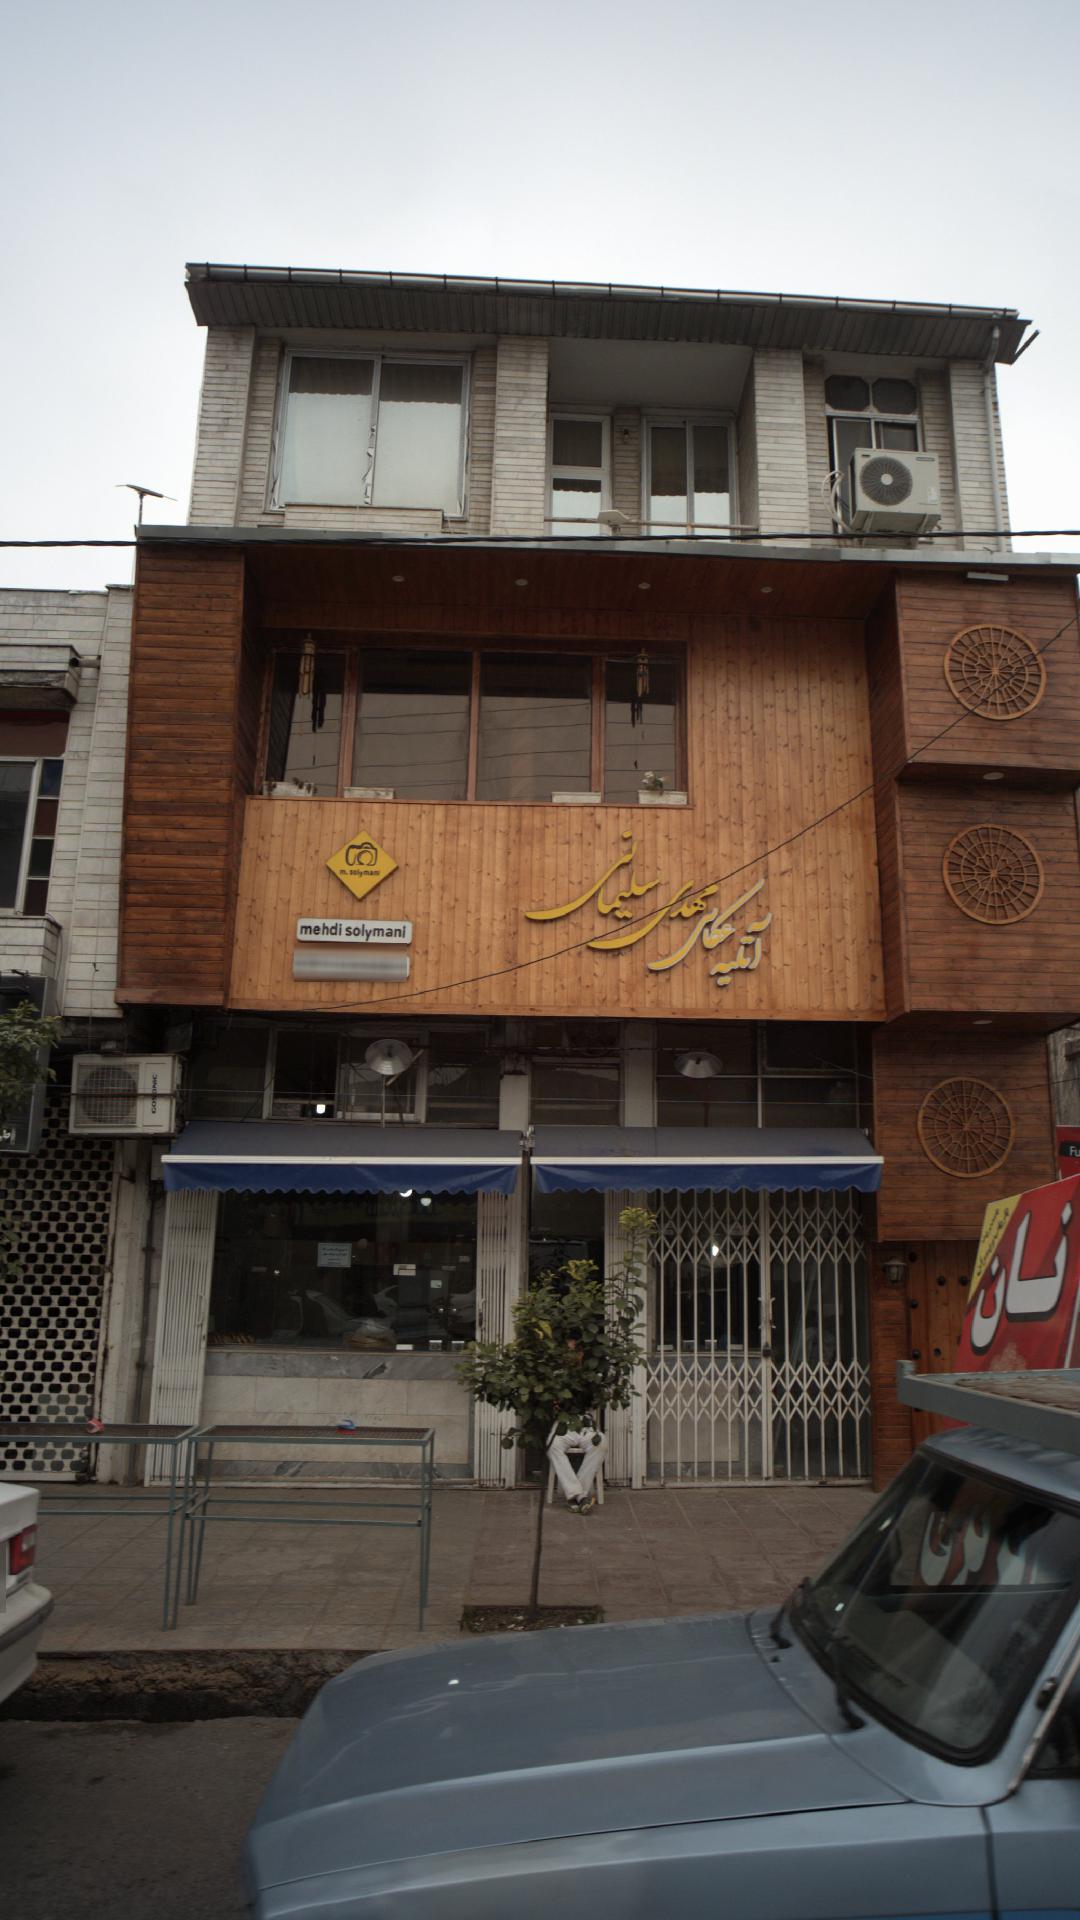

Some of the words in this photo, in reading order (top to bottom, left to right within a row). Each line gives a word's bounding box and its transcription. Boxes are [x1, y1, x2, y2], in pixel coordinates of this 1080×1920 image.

[525, 830, 661, 920] سلیمانی
[586, 880, 719, 949] مهدی
[300, 922, 343, 936] mehdi
[345, 923, 407, 942] solymani
[648, 879, 766, 971] عکاسی
[709, 911, 773, 986] آتلیه
[971, 1200, 1072, 1348] نان
